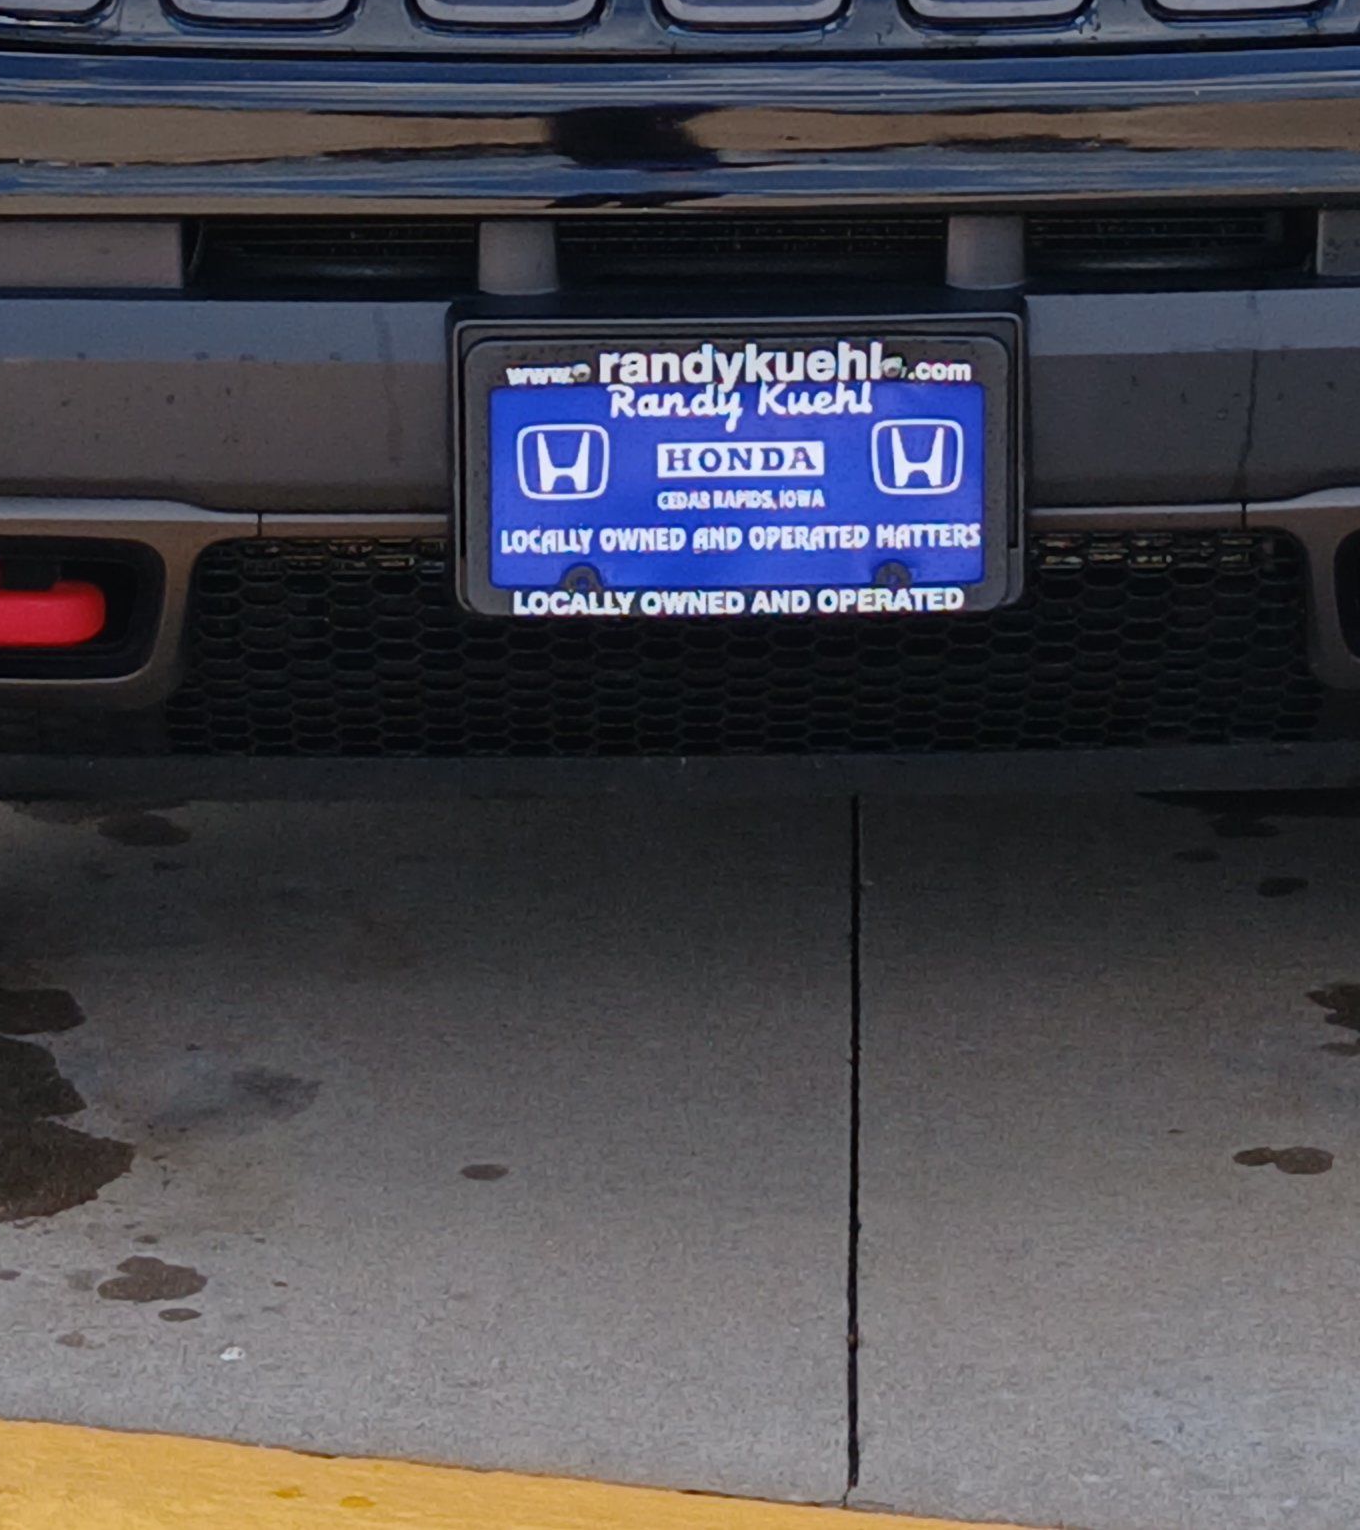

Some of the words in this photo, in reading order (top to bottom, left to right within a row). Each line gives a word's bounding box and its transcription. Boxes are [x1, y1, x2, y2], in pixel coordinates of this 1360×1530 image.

[606, 384, 743, 433] Randy
[757, 381, 873, 416] Kuehl
[665, 446, 816, 473] HONDA
[779, 488, 825, 508] IOWA
[501, 528, 593, 554] LOCALLY
[599, 527, 687, 552] OWNED
[693, 526, 743, 553] AND
[748, 525, 870, 551] OPERATED
[876, 523, 980, 548] MATTERS
[513, 590, 635, 615] LOCALLY
[640, 589, 745, 615] OWNED
[751, 589, 811, 614] AND
[817, 587, 965, 613] OPERATED
